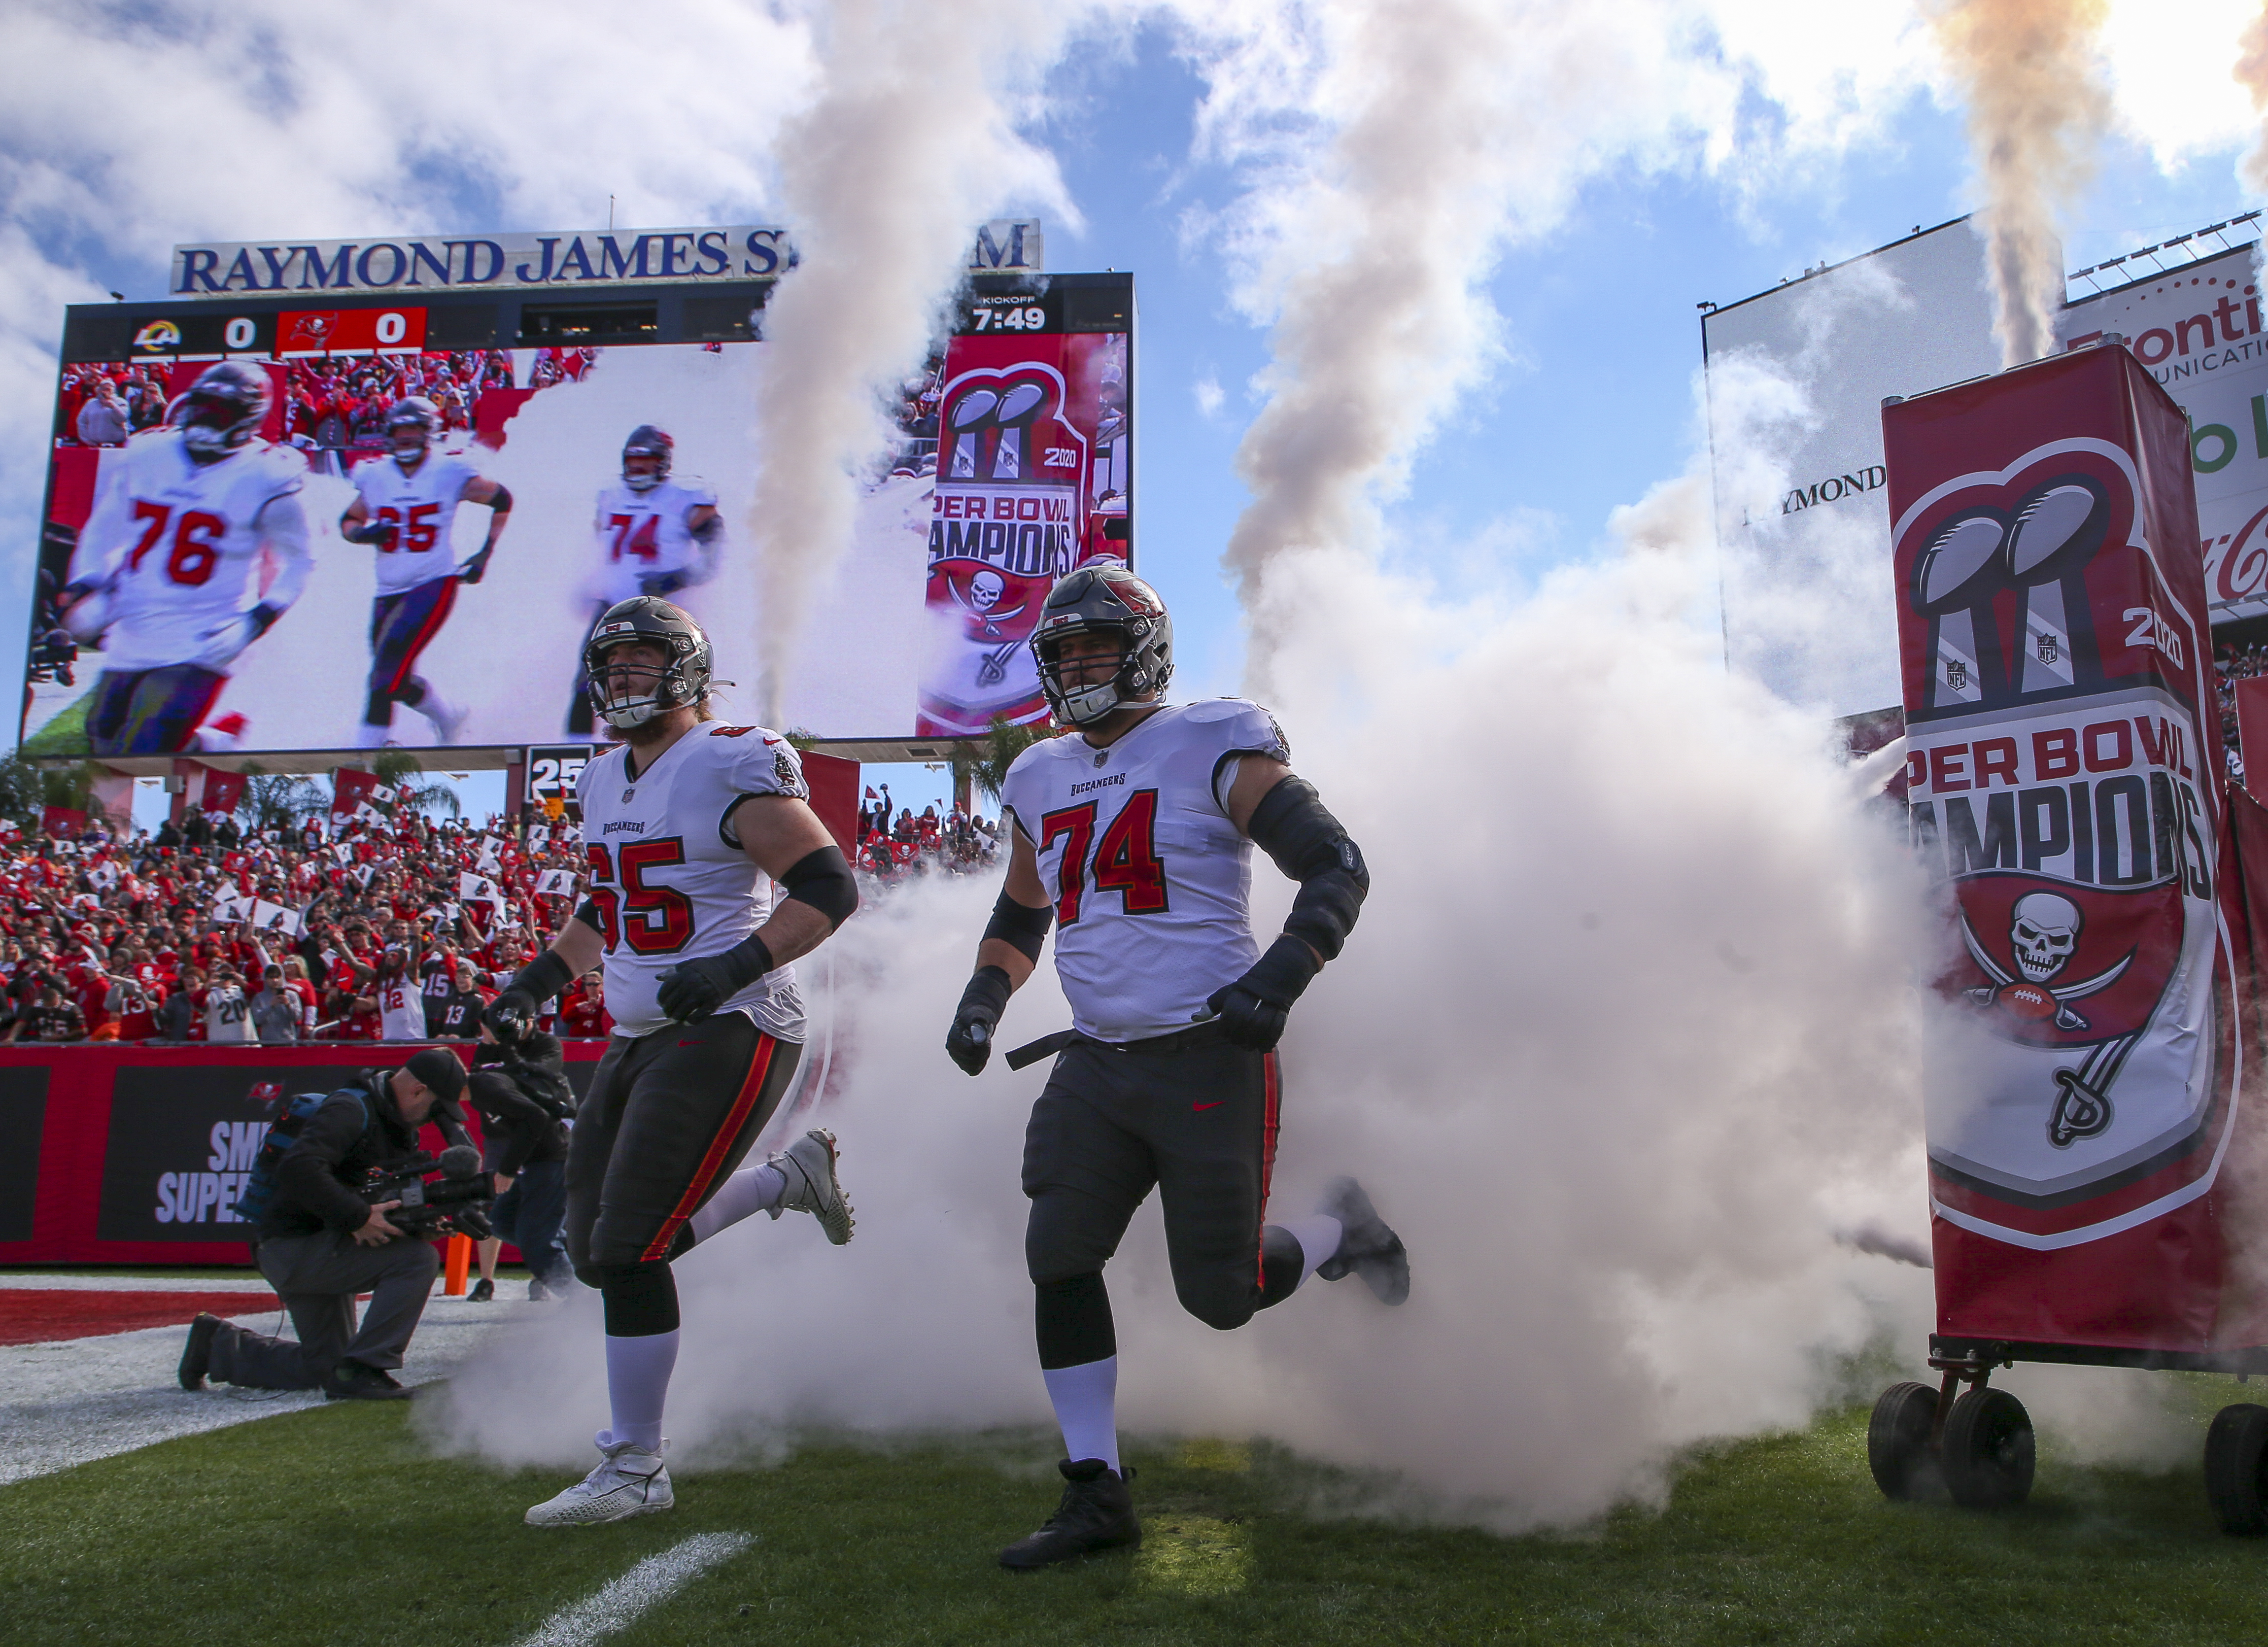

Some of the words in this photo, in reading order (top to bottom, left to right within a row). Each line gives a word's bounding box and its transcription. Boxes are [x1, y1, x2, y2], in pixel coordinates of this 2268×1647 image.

[175, 239, 505, 293] RAYMOND
[516, 231, 729, 283] JAMES
[982, 296, 1036, 304] KICKOFF
[225, 318, 256, 349] 0
[375, 313, 406, 344] 0
[973, 307, 1046, 331] 7:49
[1044, 448, 1076, 468] 2020
[993, 497, 1070, 522] BOWL
[129, 499, 225, 586] 76
[607, 513, 662, 565] 74
[2039, 646, 2055, 660] NFL
[2123, 607, 2184, 670] 2020
[1948, 672, 1965, 686] NFL
[2031, 715, 2193, 782] BOWL
[532, 758, 586, 791] 25
[1071, 772, 1126, 797] BUCCANEERS
[1038, 787, 1170, 932] 74
[218, 998, 246, 1025] 20
[444, 1005, 466, 1024] 13
